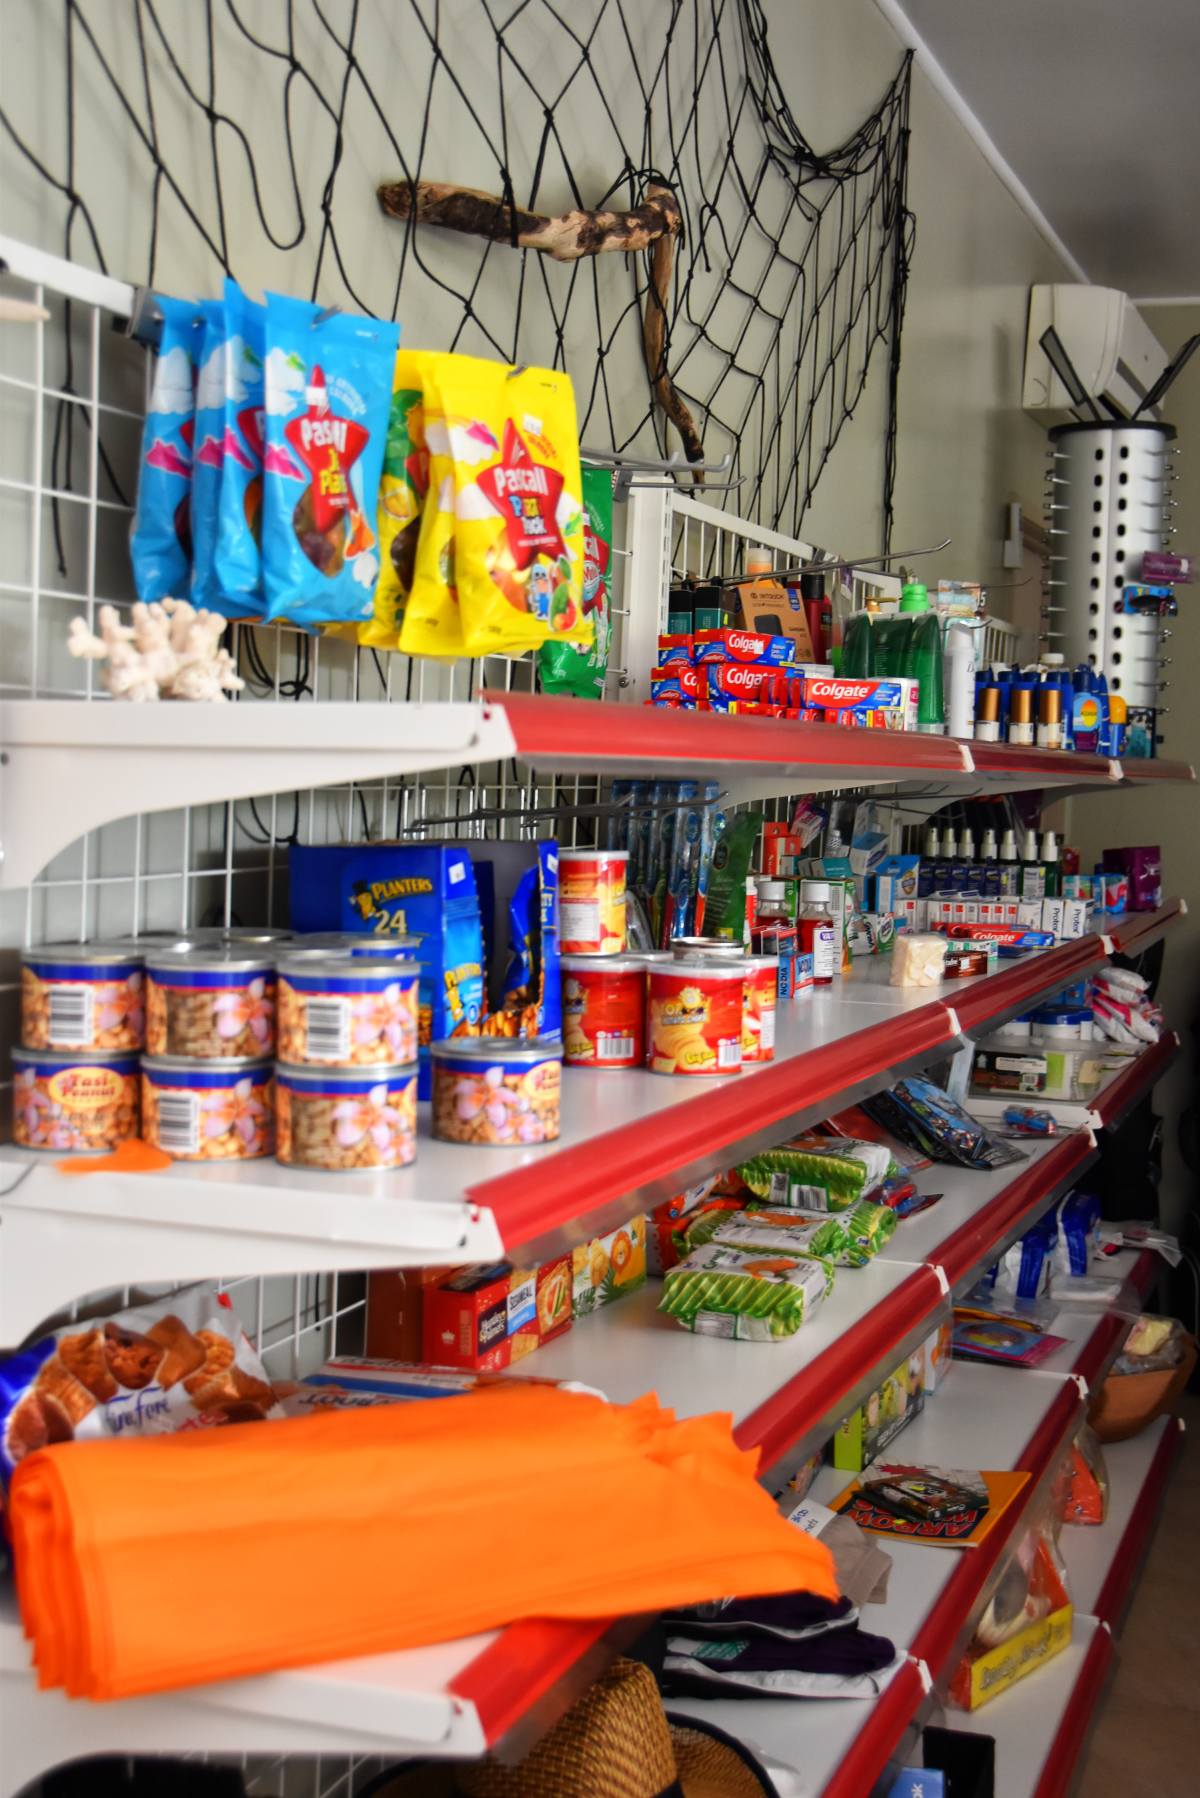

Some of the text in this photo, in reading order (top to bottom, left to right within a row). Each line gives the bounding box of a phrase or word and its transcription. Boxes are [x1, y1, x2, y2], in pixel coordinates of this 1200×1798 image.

[494, 466, 549, 497] Pascall
[729, 633, 764, 654] Colga
[727, 667, 777, 689] Colga
[811, 682, 868, 699] Colgate
[370, 877, 433, 900] PLANTERS
[374, 910, 407, 934] 24
[973, 932, 1016, 942] Colgate
